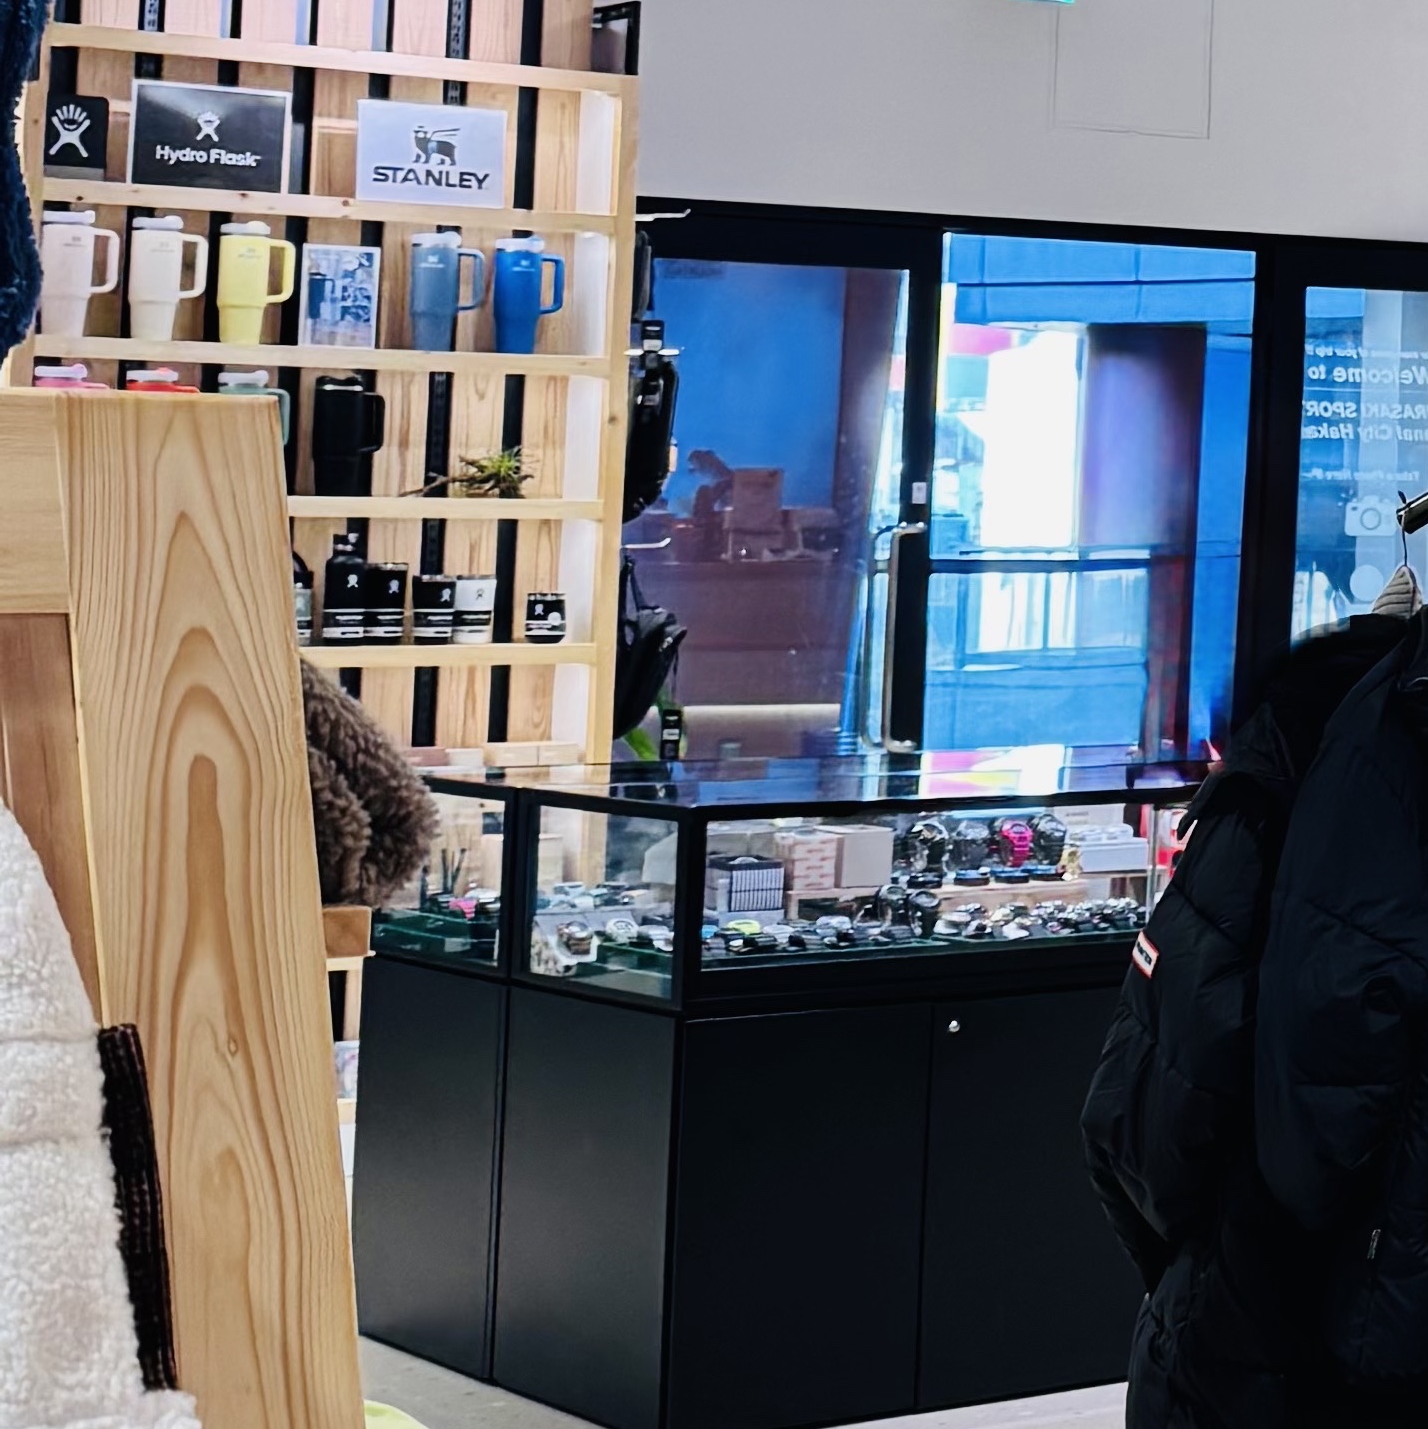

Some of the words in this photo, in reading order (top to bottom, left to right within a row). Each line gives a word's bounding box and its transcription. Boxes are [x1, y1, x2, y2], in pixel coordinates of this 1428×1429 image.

[156, 145, 207, 164] Hydro
[210, 149, 258, 167] Flask
[372, 166, 490, 190] STANLEY
